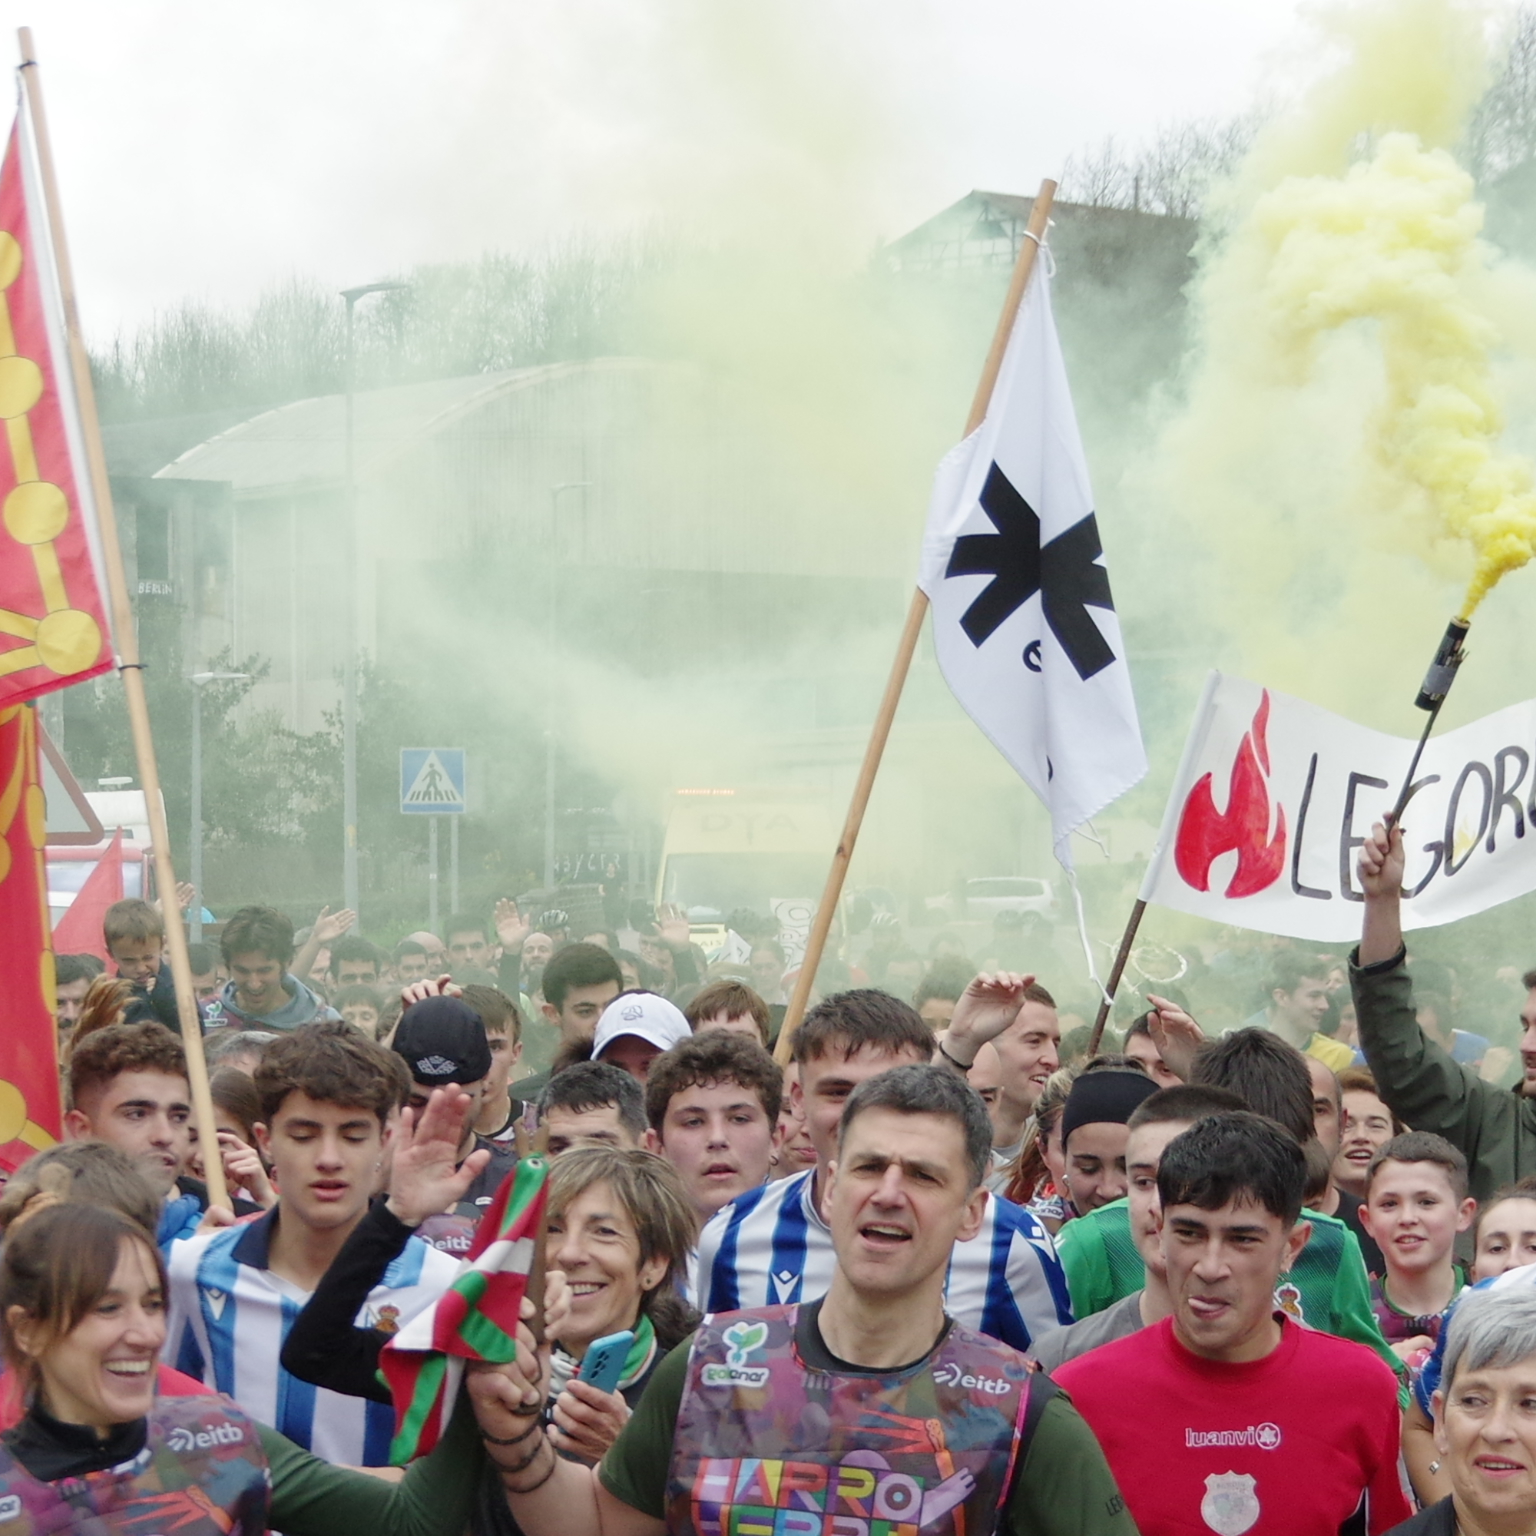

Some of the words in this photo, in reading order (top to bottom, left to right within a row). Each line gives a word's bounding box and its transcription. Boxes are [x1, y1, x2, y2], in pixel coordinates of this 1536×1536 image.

[699, 812, 801, 846] DYA
[434, 1235, 473, 1251] eitb
[705, 1366, 766, 1385] goiener
[960, 1374, 1012, 1395] eitb
[196, 1421, 244, 1450] eitb
[1185, 1426, 1255, 1448] luanvi
[691, 1456, 924, 1525] HARRO
